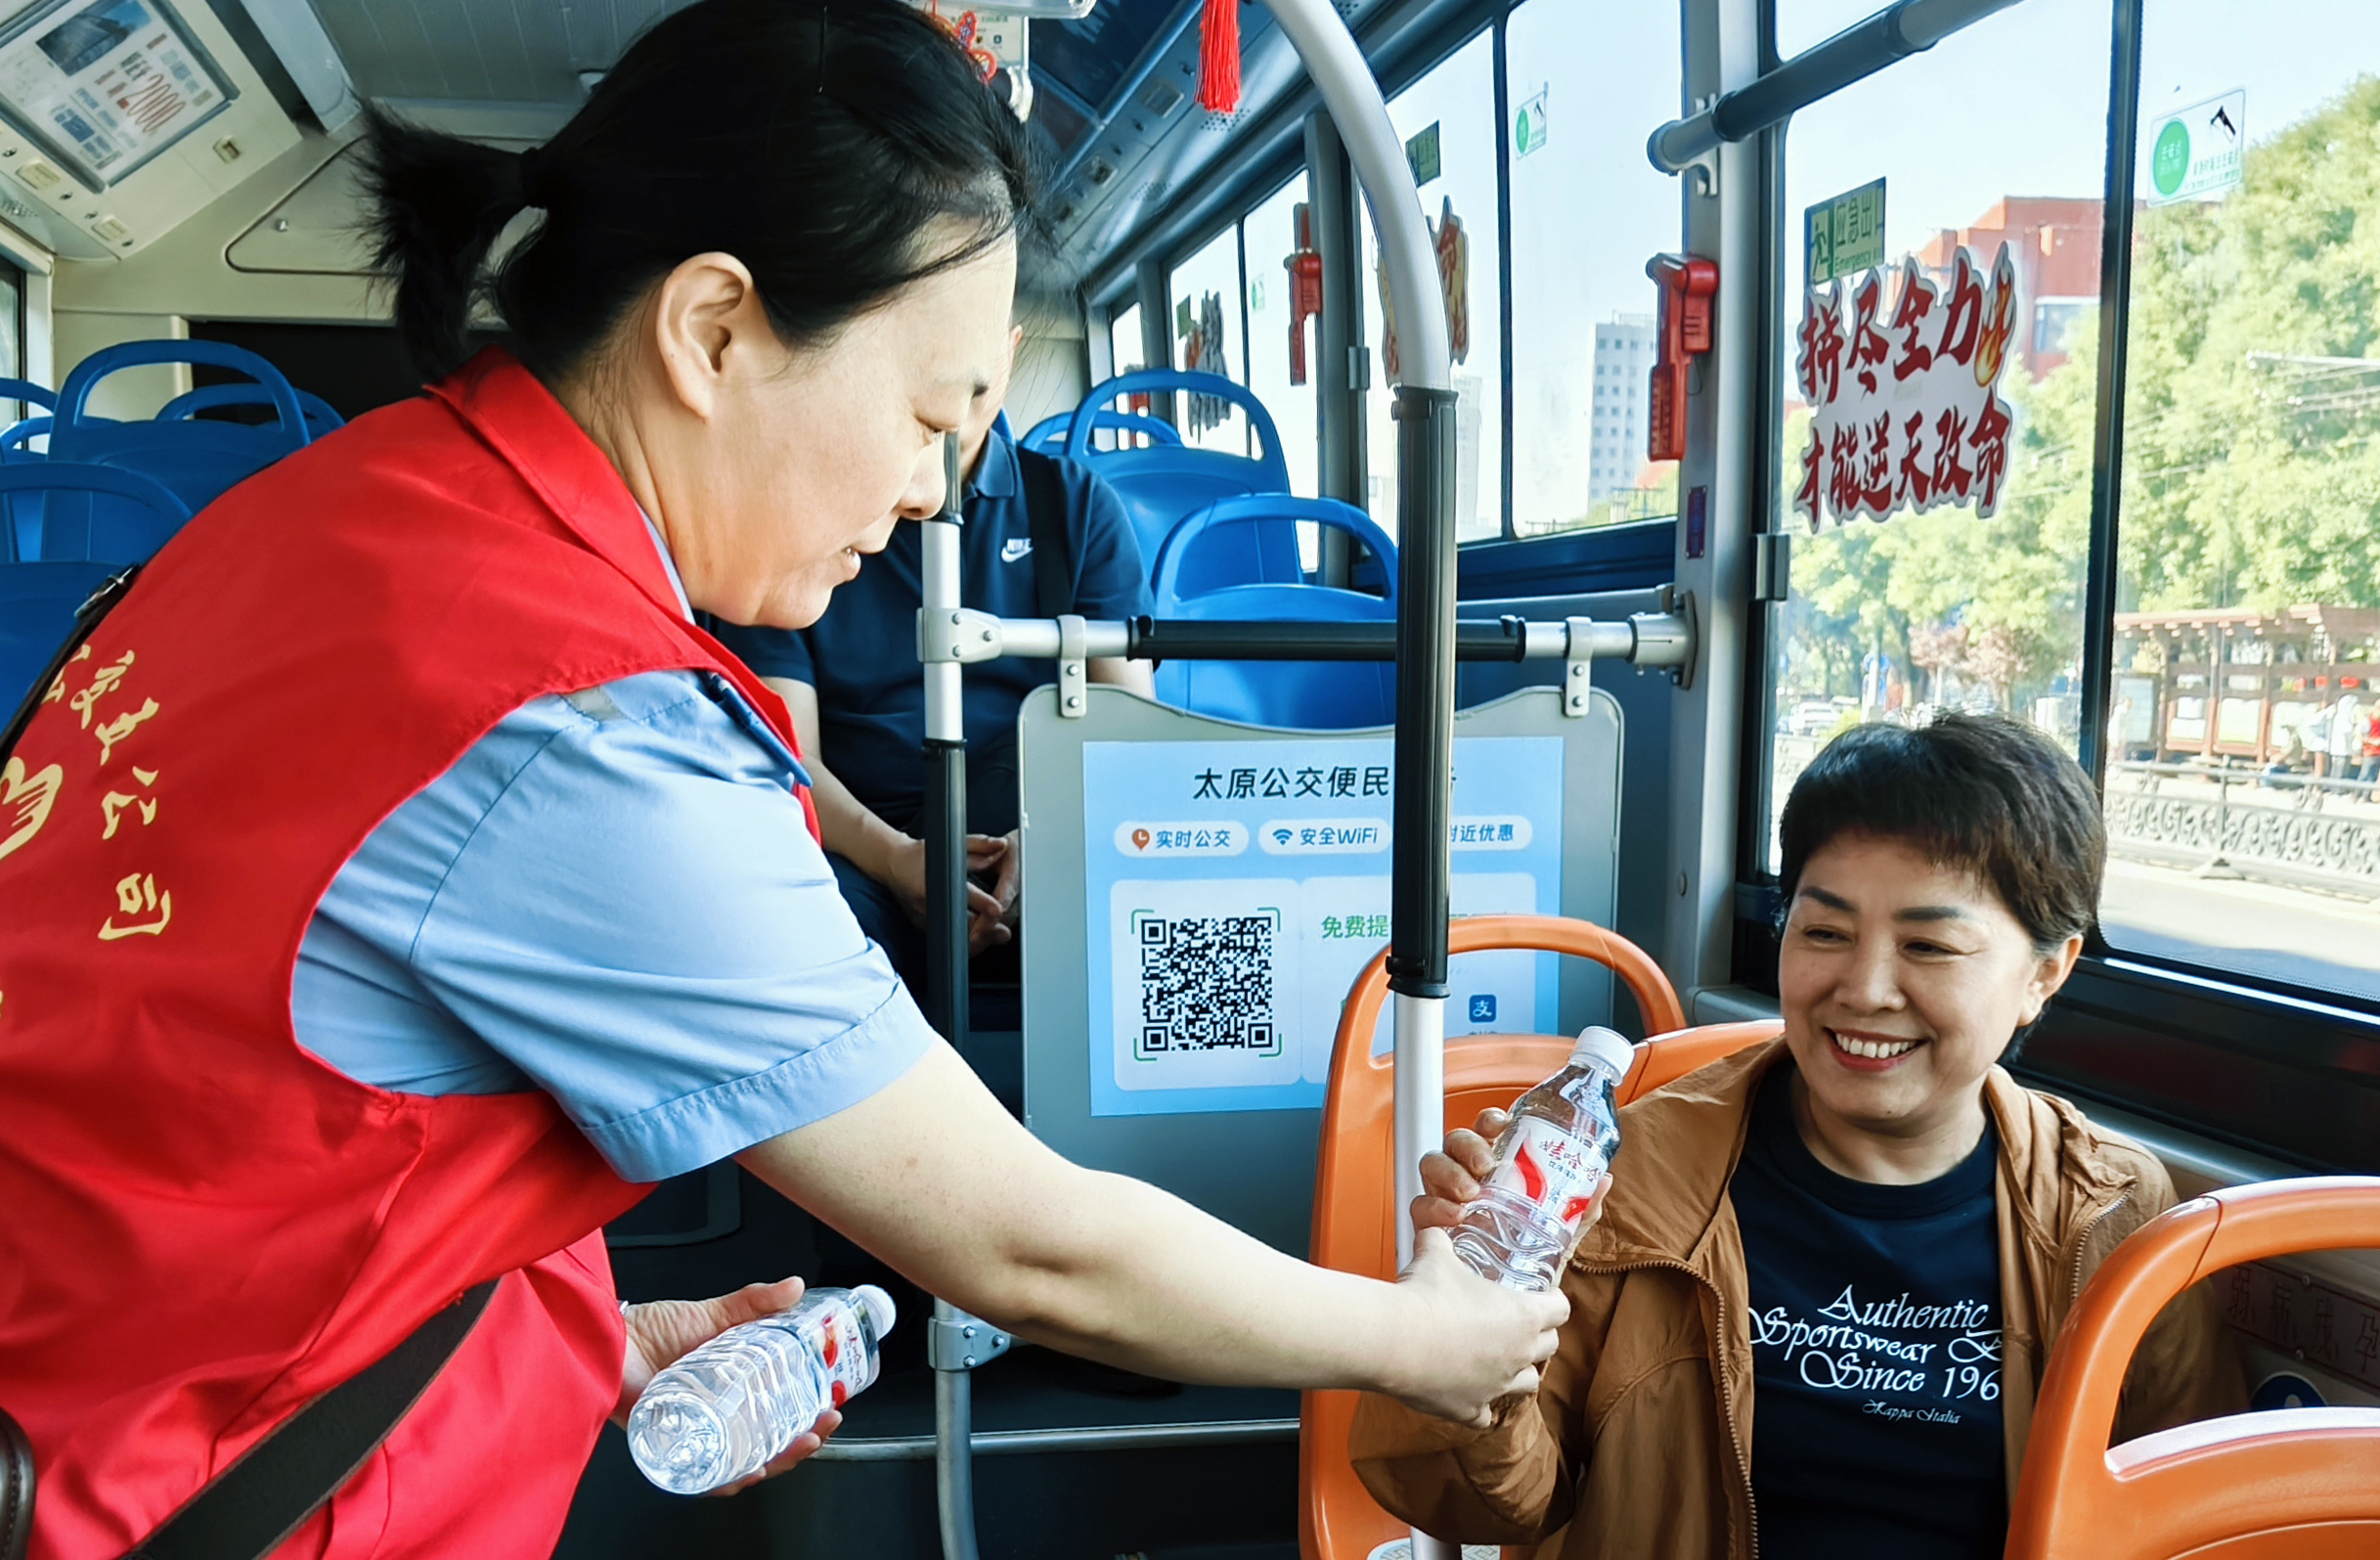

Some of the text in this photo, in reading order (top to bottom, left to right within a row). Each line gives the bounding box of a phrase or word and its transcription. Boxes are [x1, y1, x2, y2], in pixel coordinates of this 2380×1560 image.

[1800, 257, 1983, 406] 拼尽全力
[1796, 386, 2010, 524] 才能逆天改命
[1156, 829, 1231, 848] 实时公交
[1817, 1283, 1989, 1328] Authentic
[1748, 1307, 1937, 1363] Sportswear
[1800, 1350, 1925, 1391] Since
[1863, 1399, 1961, 1425] Kappa Italia
